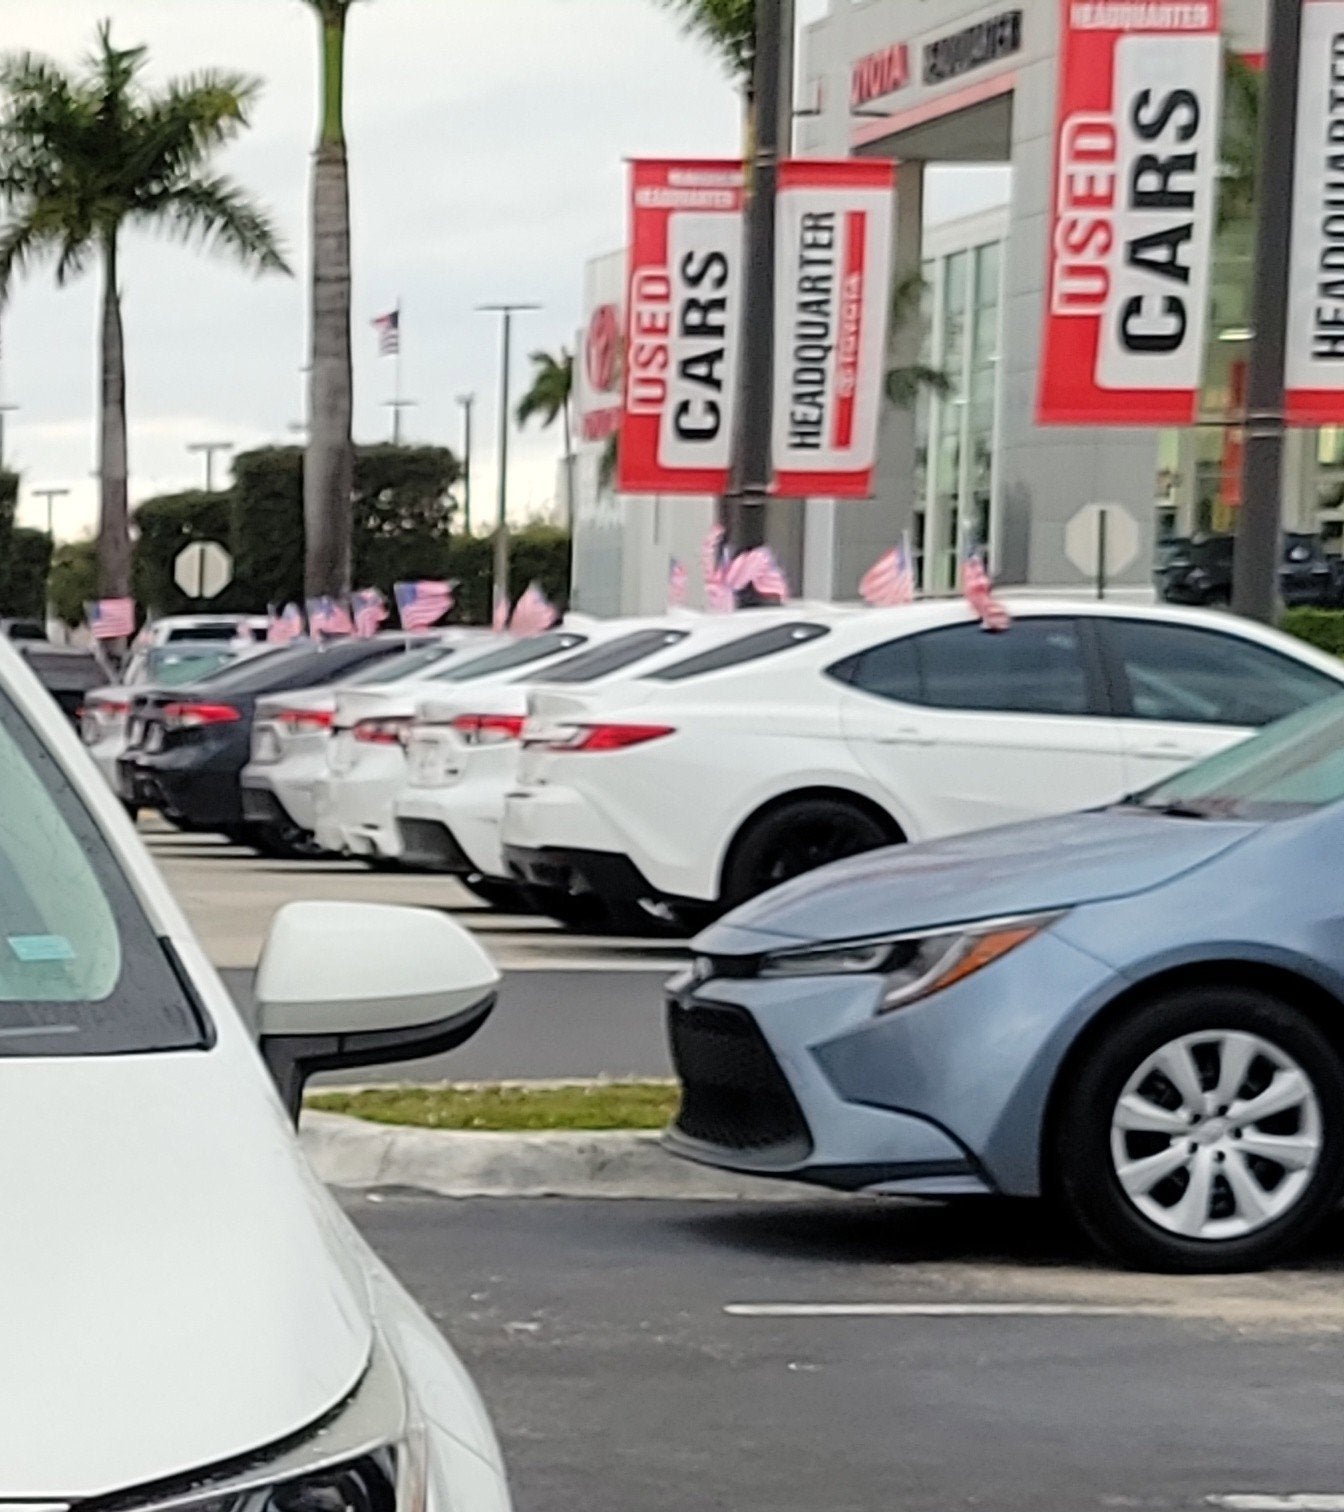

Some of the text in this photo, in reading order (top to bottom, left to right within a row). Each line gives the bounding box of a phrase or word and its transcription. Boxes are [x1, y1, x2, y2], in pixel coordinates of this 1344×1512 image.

[1063, 121, 1116, 307] USED
[1121, 87, 1200, 354] CARS
[632, 273, 670, 408] USED
[674, 250, 728, 441] CARS
[786, 211, 836, 450] HEADQUARTER
